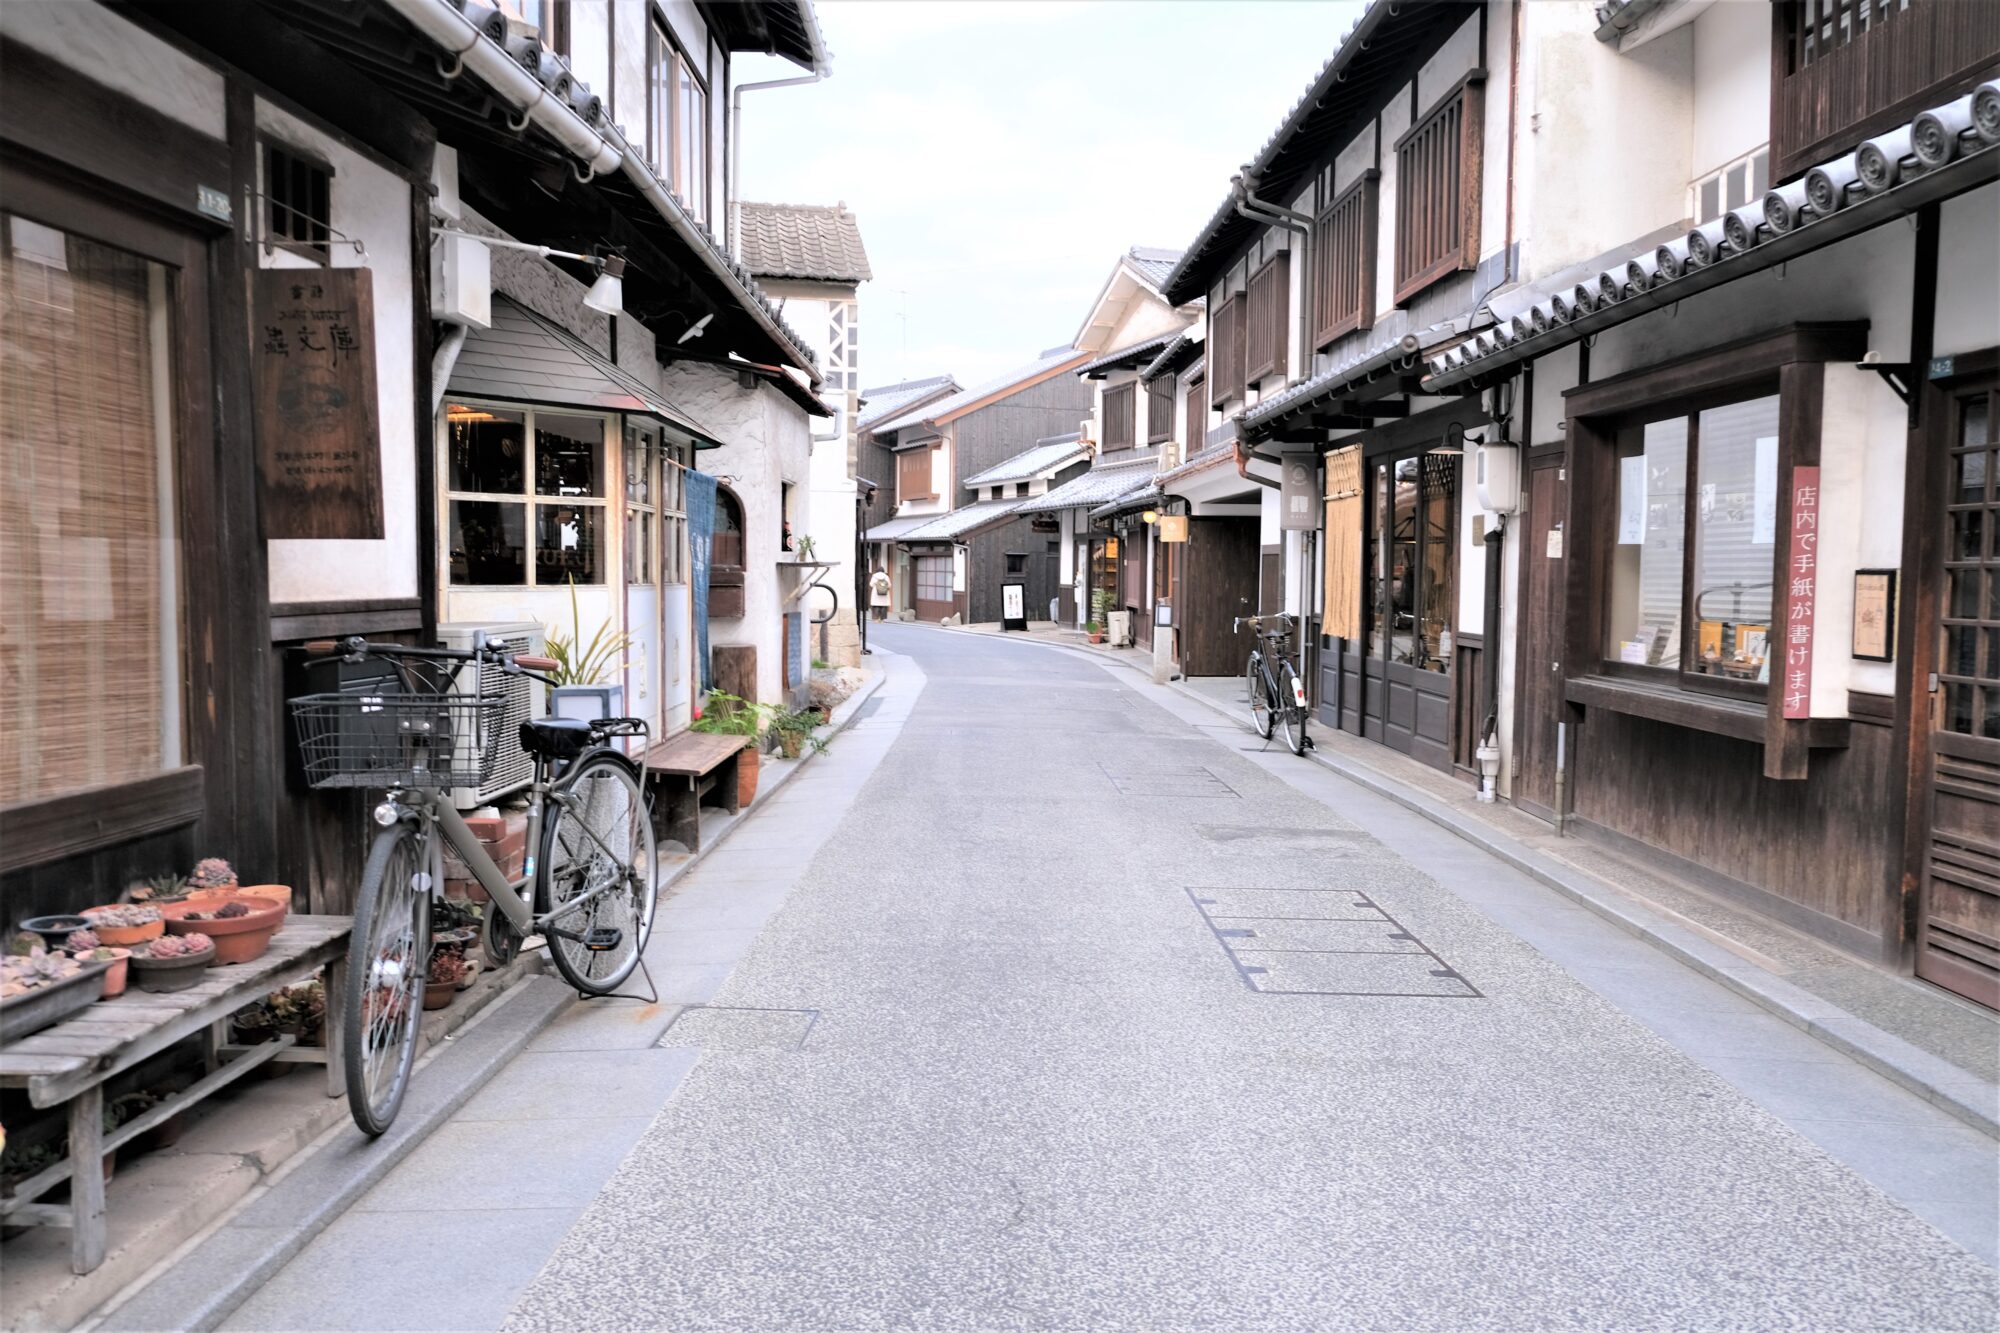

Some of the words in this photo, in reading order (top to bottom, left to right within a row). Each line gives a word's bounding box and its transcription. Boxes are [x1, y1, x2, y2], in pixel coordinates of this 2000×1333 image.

[1785, 486, 1817, 712] 店内で手紙が書けます
